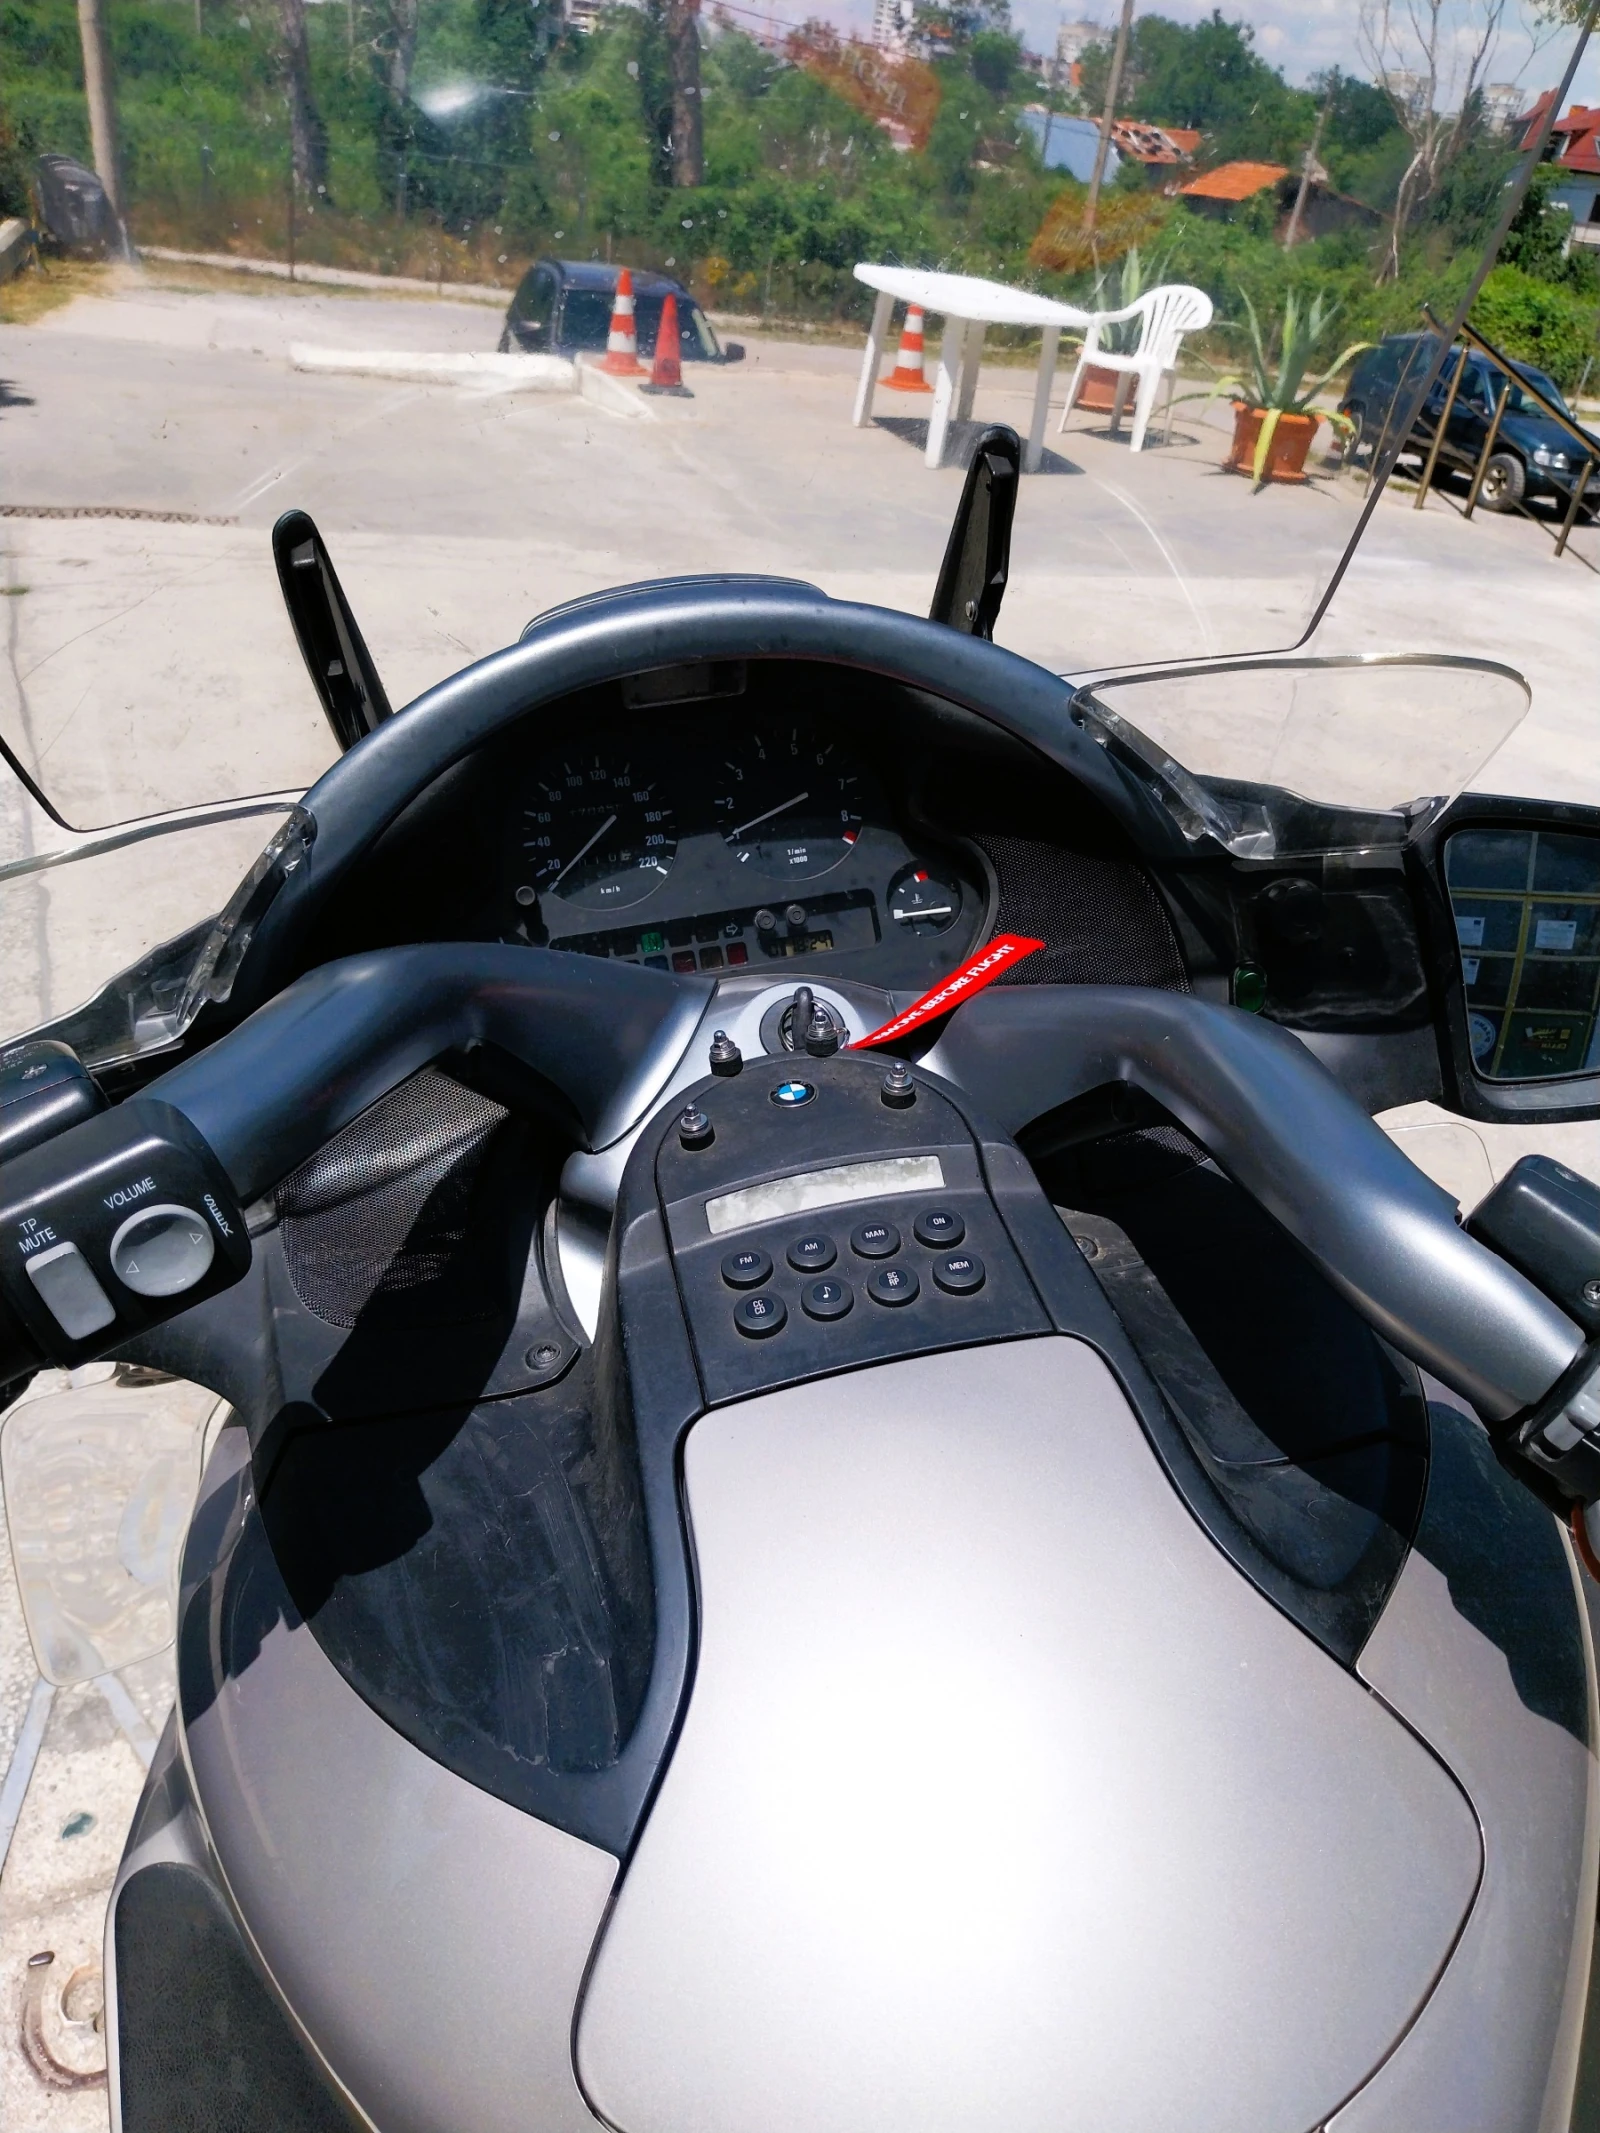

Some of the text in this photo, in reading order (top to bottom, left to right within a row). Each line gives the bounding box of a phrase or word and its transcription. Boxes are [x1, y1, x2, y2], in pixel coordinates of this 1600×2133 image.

[758, 748, 767, 760] 4
[790, 743, 799, 756] 5
[816, 753, 824, 765] 6
[589, 769, 607, 781] 120
[735, 768, 744, 780] 3
[566, 775, 583, 787] 100
[612, 776, 631, 788] 140
[837, 778, 846, 790] 7
[548, 791, 562, 802] 80
[632, 790, 650, 803] 160
[726, 797, 735, 809] 2
[537, 812, 551, 823] 60
[644, 811, 662, 822] 180
[840, 809, 849, 821] 8
[536, 836, 551, 847] 40
[645, 834, 665, 846] 200
[787, 847, 806, 855] 1/min
[547, 859, 561, 870] 20
[638, 856, 658, 868] 220
[600, 886, 620, 894] km/h
[920, 976, 973, 1010] BEFORE
[966, 944, 1015, 976] FLIGHT
[104, 1176, 156, 1209] VOLUME
[203, 1194, 234, 1237] SEEK
[933, 1217, 946, 1226] ON
[19, 1218, 37, 1234] TP
[19, 1227, 57, 1253] MUTE
[865, 1229, 885, 1239] MAN
[804, 1242, 818, 1251] AM
[739, 1255, 753, 1265] FM
[948, 1260, 970, 1271] MEM
[886, 1271, 898, 1279] SC
[889, 1278, 900, 1286] RP
[752, 1299, 763, 1307] CC
[754, 1305, 766, 1315] CD
